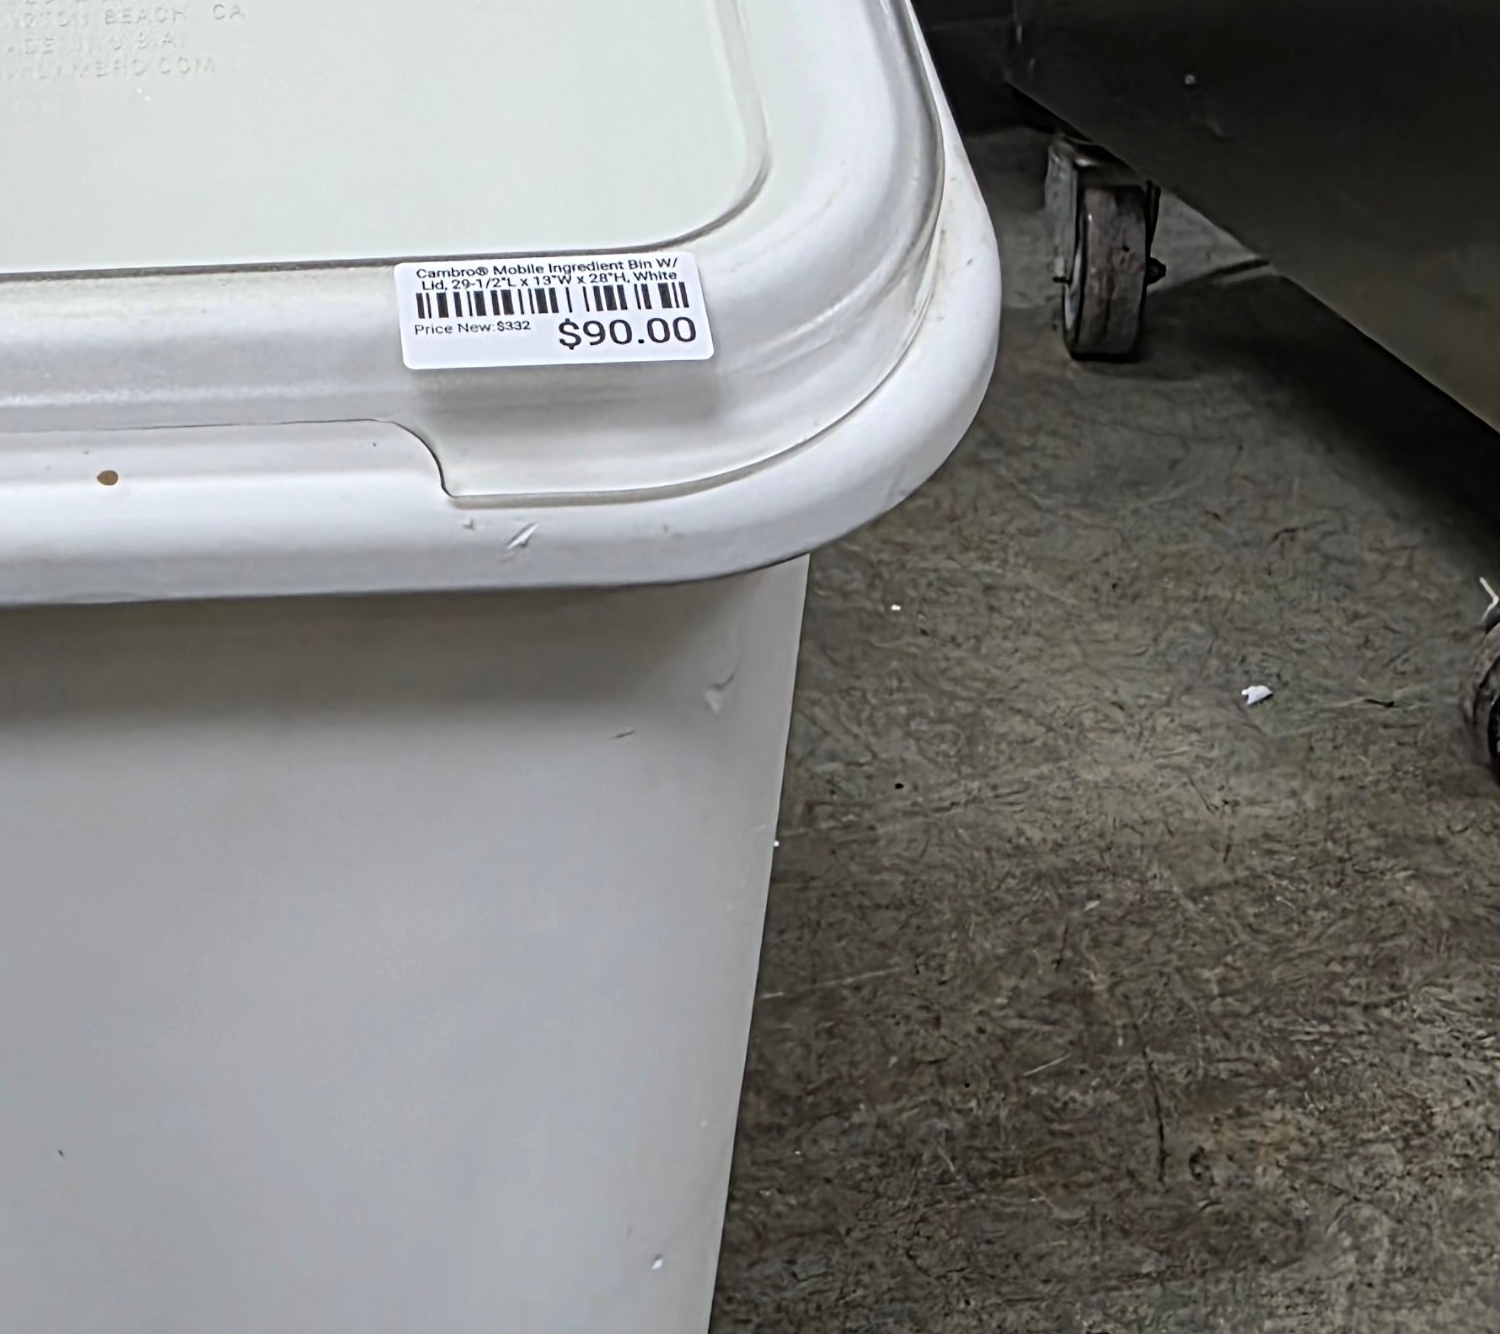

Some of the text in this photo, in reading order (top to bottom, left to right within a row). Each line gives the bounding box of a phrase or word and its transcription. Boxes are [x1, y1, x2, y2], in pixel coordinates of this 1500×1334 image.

[493, 264, 545, 276] Mobile
[548, 260, 624, 274] Ingredient
[628, 259, 653, 270] Bin
[656, 257, 678, 268] W/
[422, 280, 448, 291] Lid,
[520, 277, 529, 286] x
[577, 275, 586, 284] x
[633, 270, 677, 281] White
[414, 323, 453, 336] Price
[558, 316, 697, 350] $90.00
